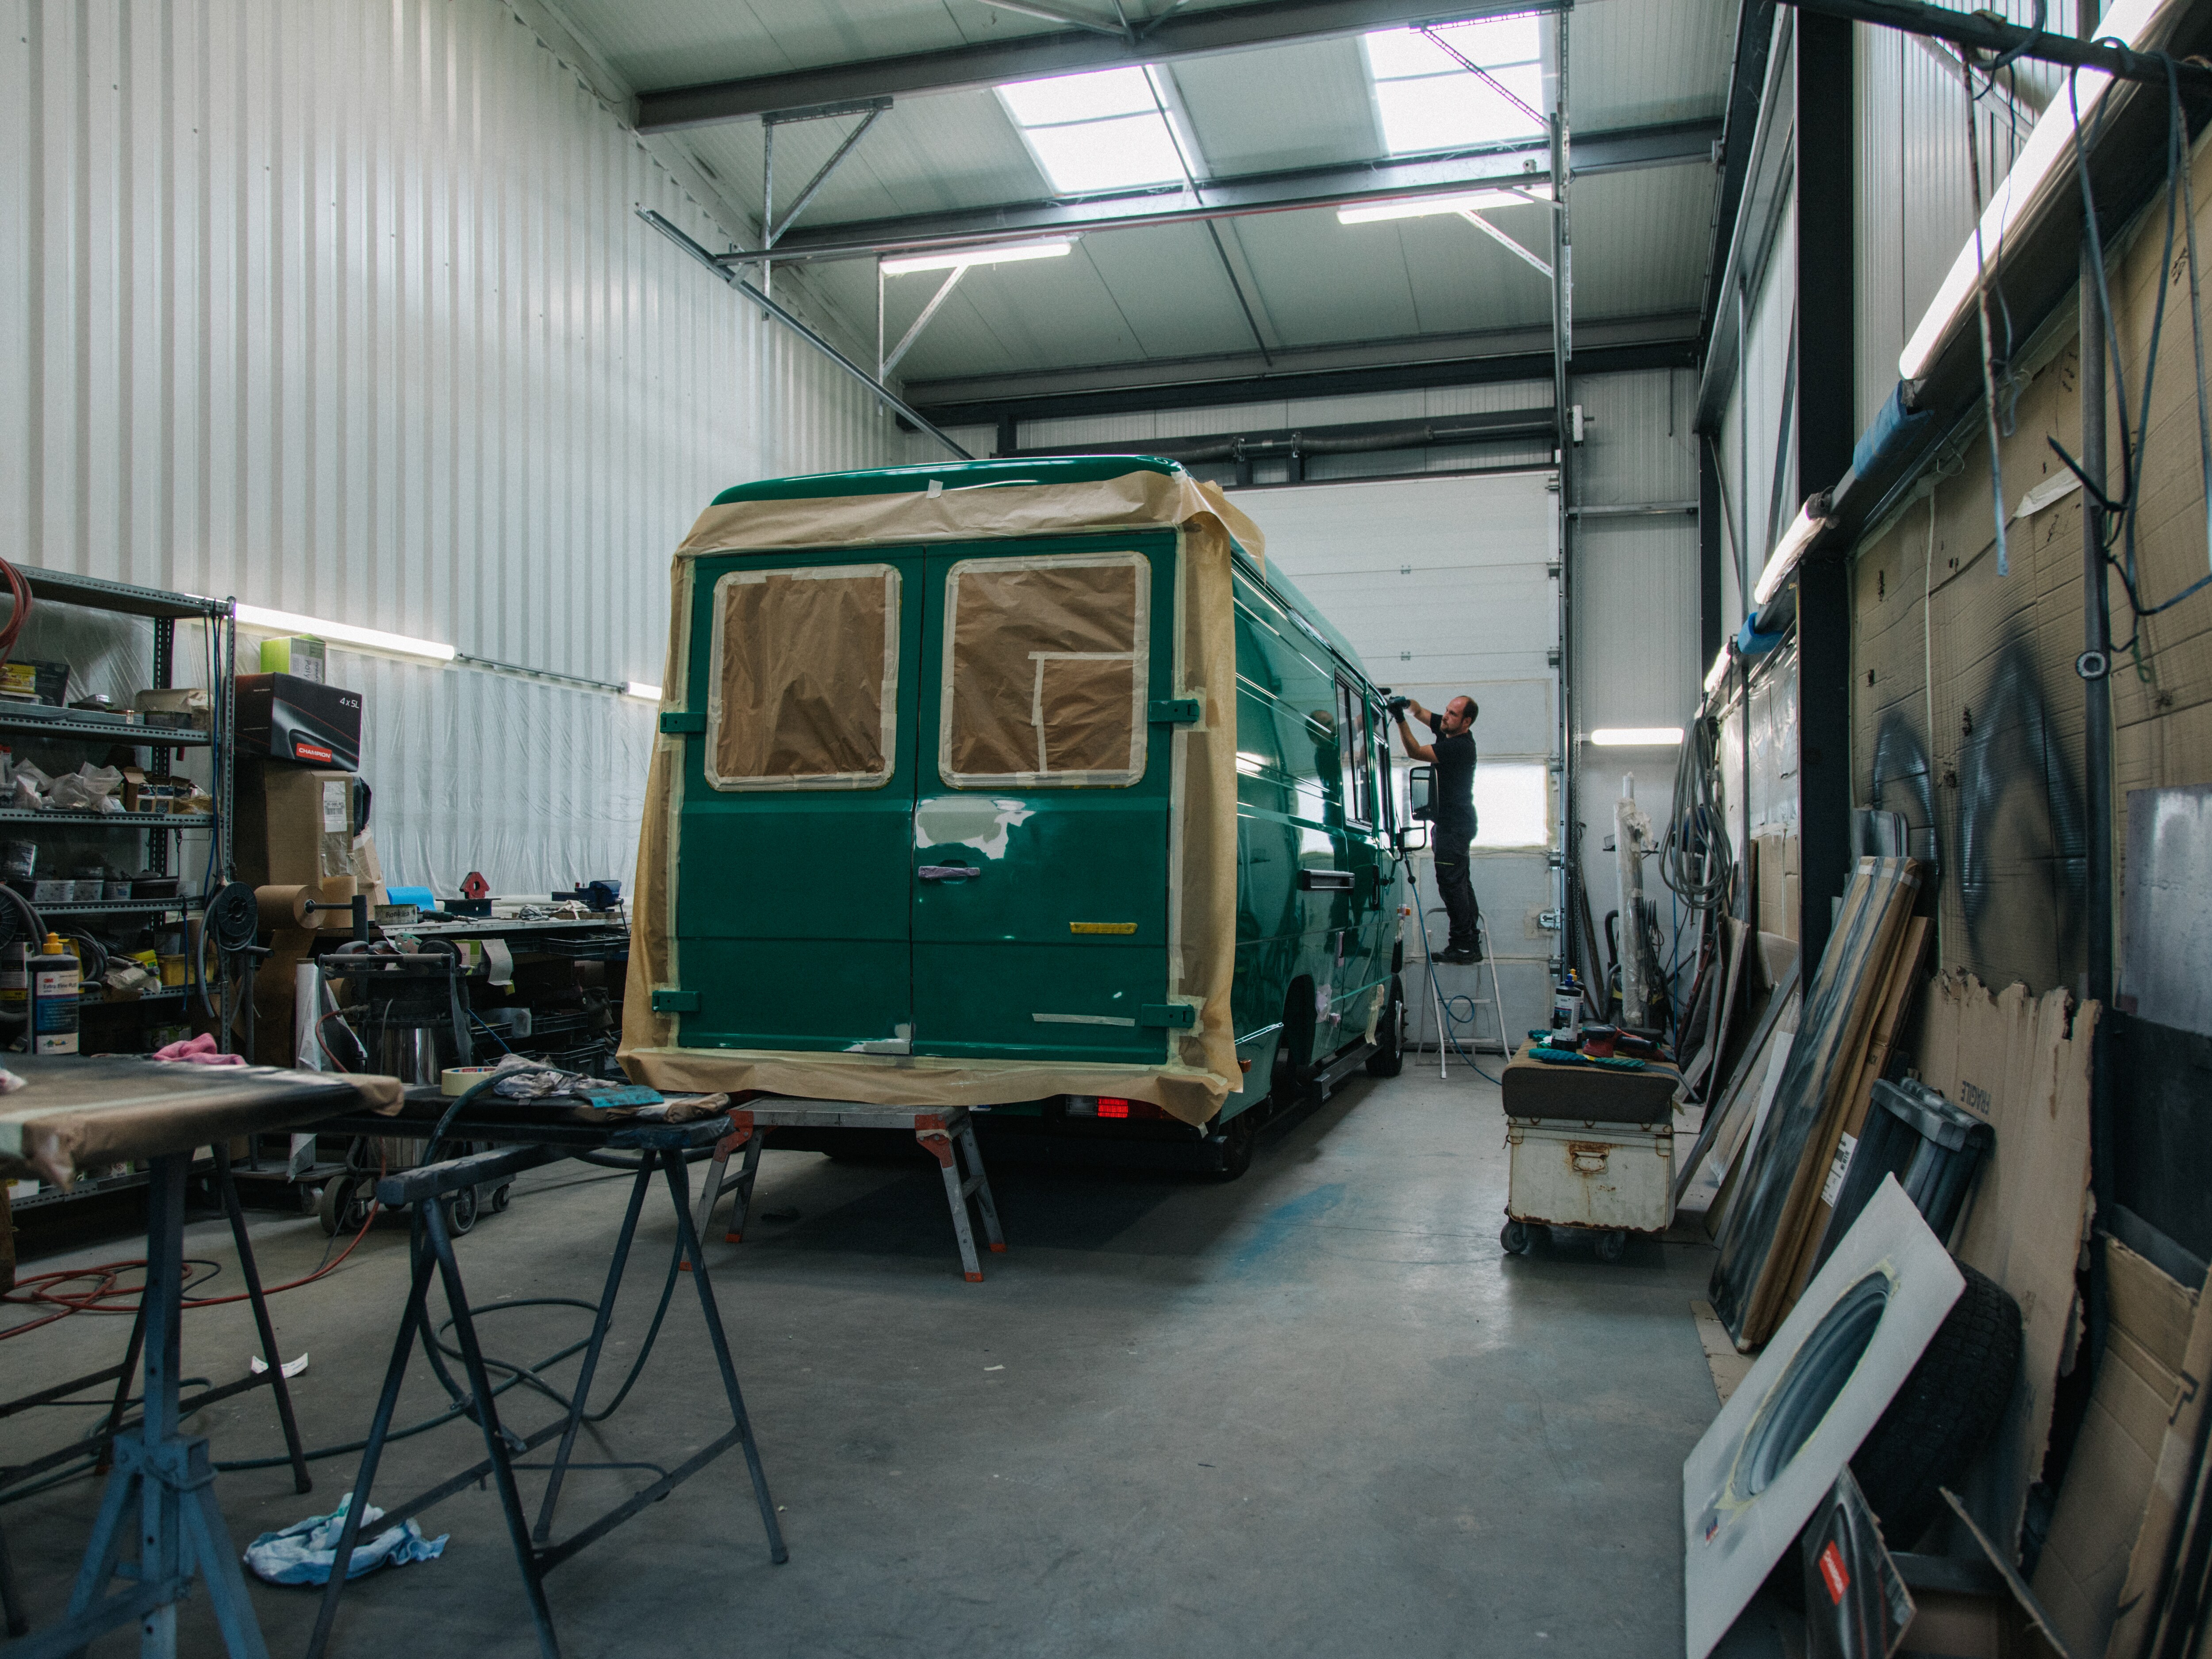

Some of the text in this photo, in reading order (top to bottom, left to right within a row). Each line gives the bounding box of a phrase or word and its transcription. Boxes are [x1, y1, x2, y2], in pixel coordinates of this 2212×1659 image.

[351, 699, 360, 709] 5L
[299, 748, 331, 759] CHAMPION
[1961, 1080, 1991, 1116] FRAGILE
